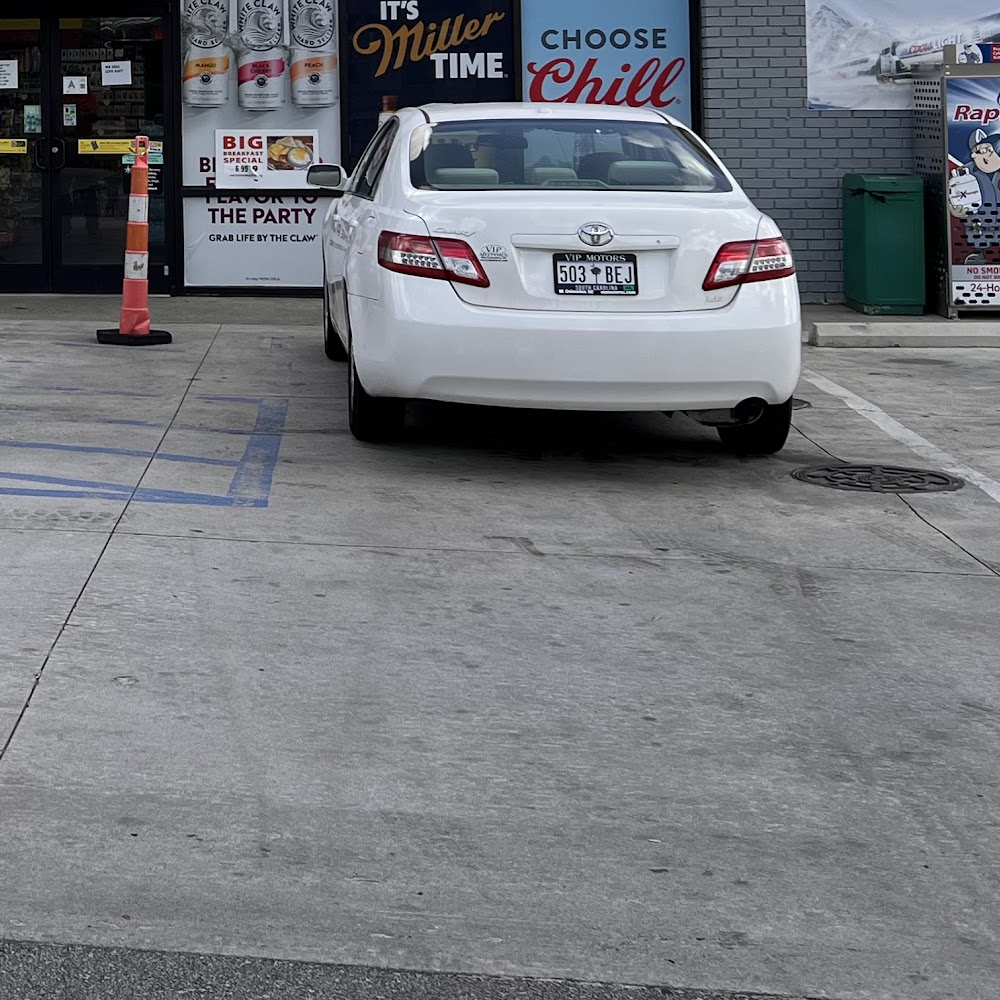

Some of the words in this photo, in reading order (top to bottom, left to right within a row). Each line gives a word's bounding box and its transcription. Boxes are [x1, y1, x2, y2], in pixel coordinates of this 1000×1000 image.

[239, 3, 253, 33] WHITE
[253, 0, 281, 16] CLAW
[291, 0, 303, 31] WHITE
[380, 0, 420, 21] IT'S
[352, 12, 505, 78] Miller
[540, 28, 668, 51] CHOOSE
[430, 52, 504, 79] TIME
[526, 56, 687, 108] Chill
[223, 136, 263, 149] BIG
[208, 208, 247, 224] THE
[253, 208, 317, 224] PARTY
[209, 234, 234, 242] GRAB
[236, 234, 255, 242] LIFE
[257, 234, 269, 242] BY
[271, 234, 288, 242] THE
[290, 234, 316, 242] CLAW
[560, 265, 586, 282] 503
[605, 266, 632, 283] BEJ
[970, 283, 1000, 292] 24-Ho
